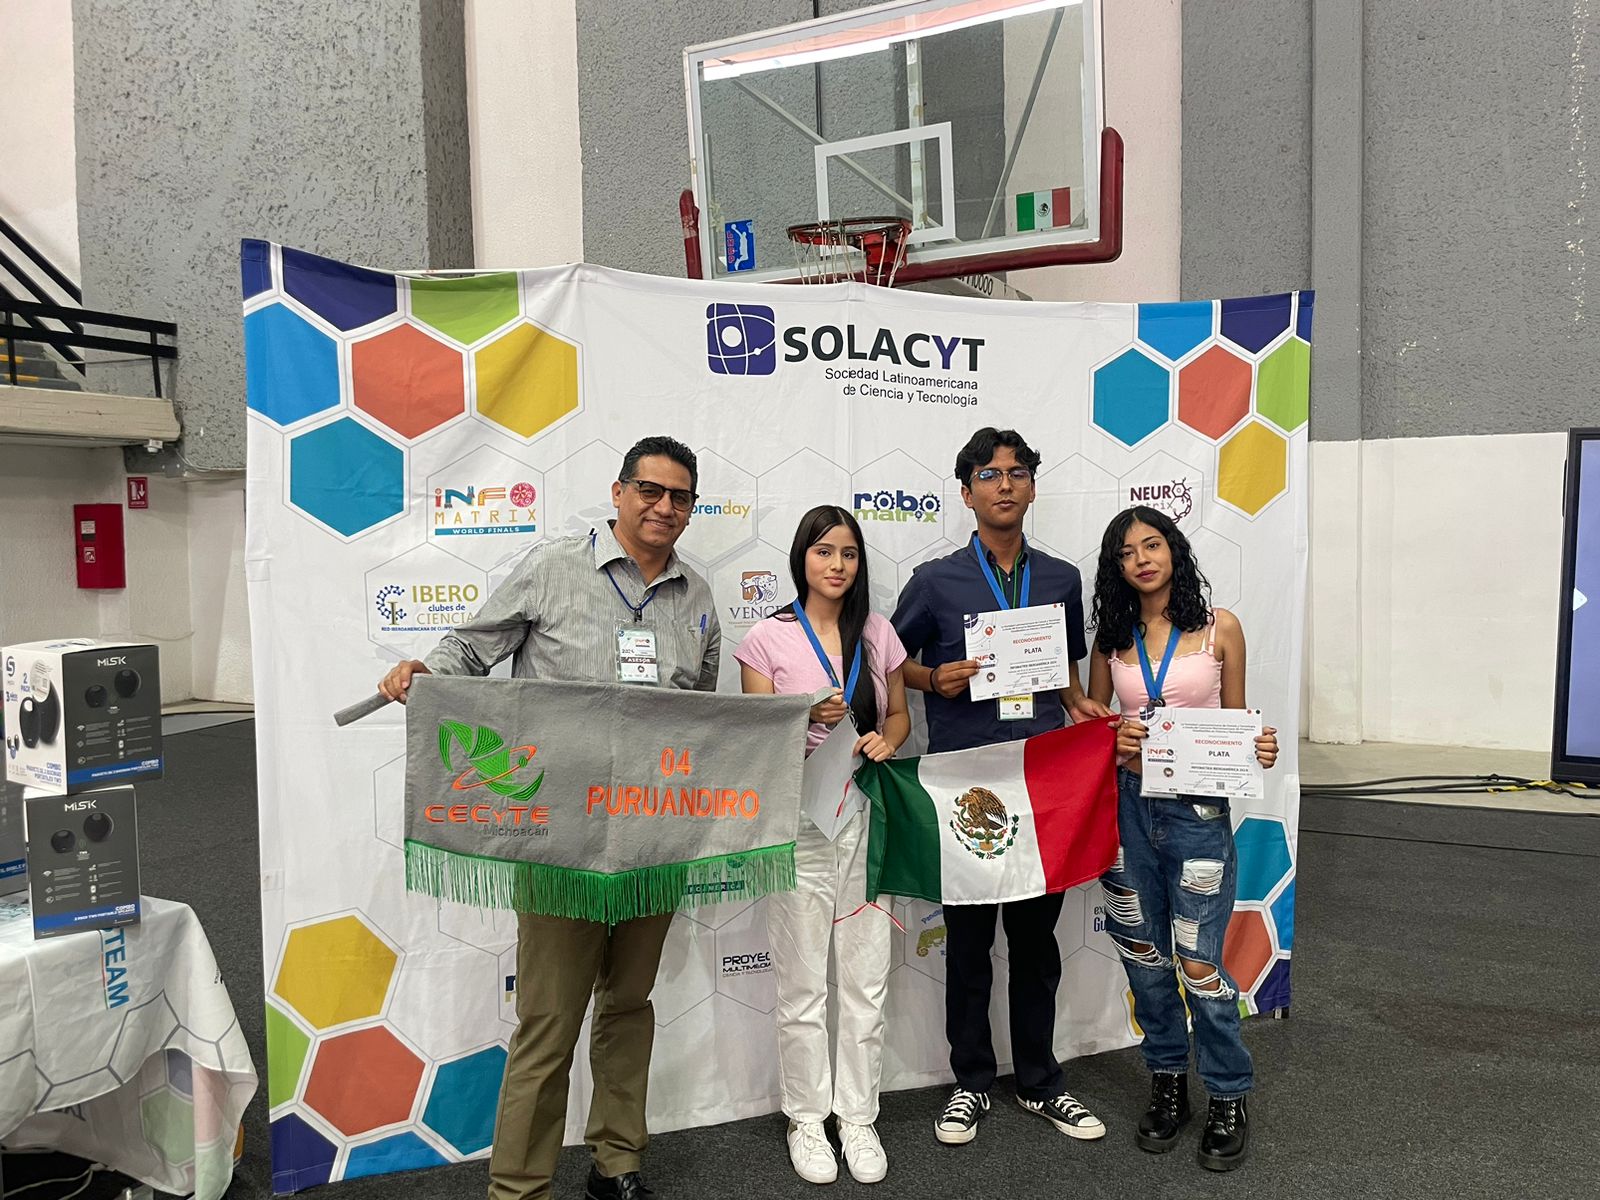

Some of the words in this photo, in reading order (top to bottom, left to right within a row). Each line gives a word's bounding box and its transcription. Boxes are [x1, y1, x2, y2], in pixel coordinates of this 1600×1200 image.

[783, 324, 985, 372] SOLACYT
[825, 367, 879, 381] Sociedad
[882, 370, 978, 390] Latinoamericana
[843, 384, 856, 396] de
[859, 384, 904, 400] Ciencia
[907, 392, 915, 403] y
[435, 508, 537, 525] MATRIX
[487, 526, 520, 534] FINALS
[412, 584, 479, 603] IBERO
[428, 604, 454, 612] clubes
[659, 746, 692, 778] 04
[586, 785, 760, 820] PURUANDIRO
